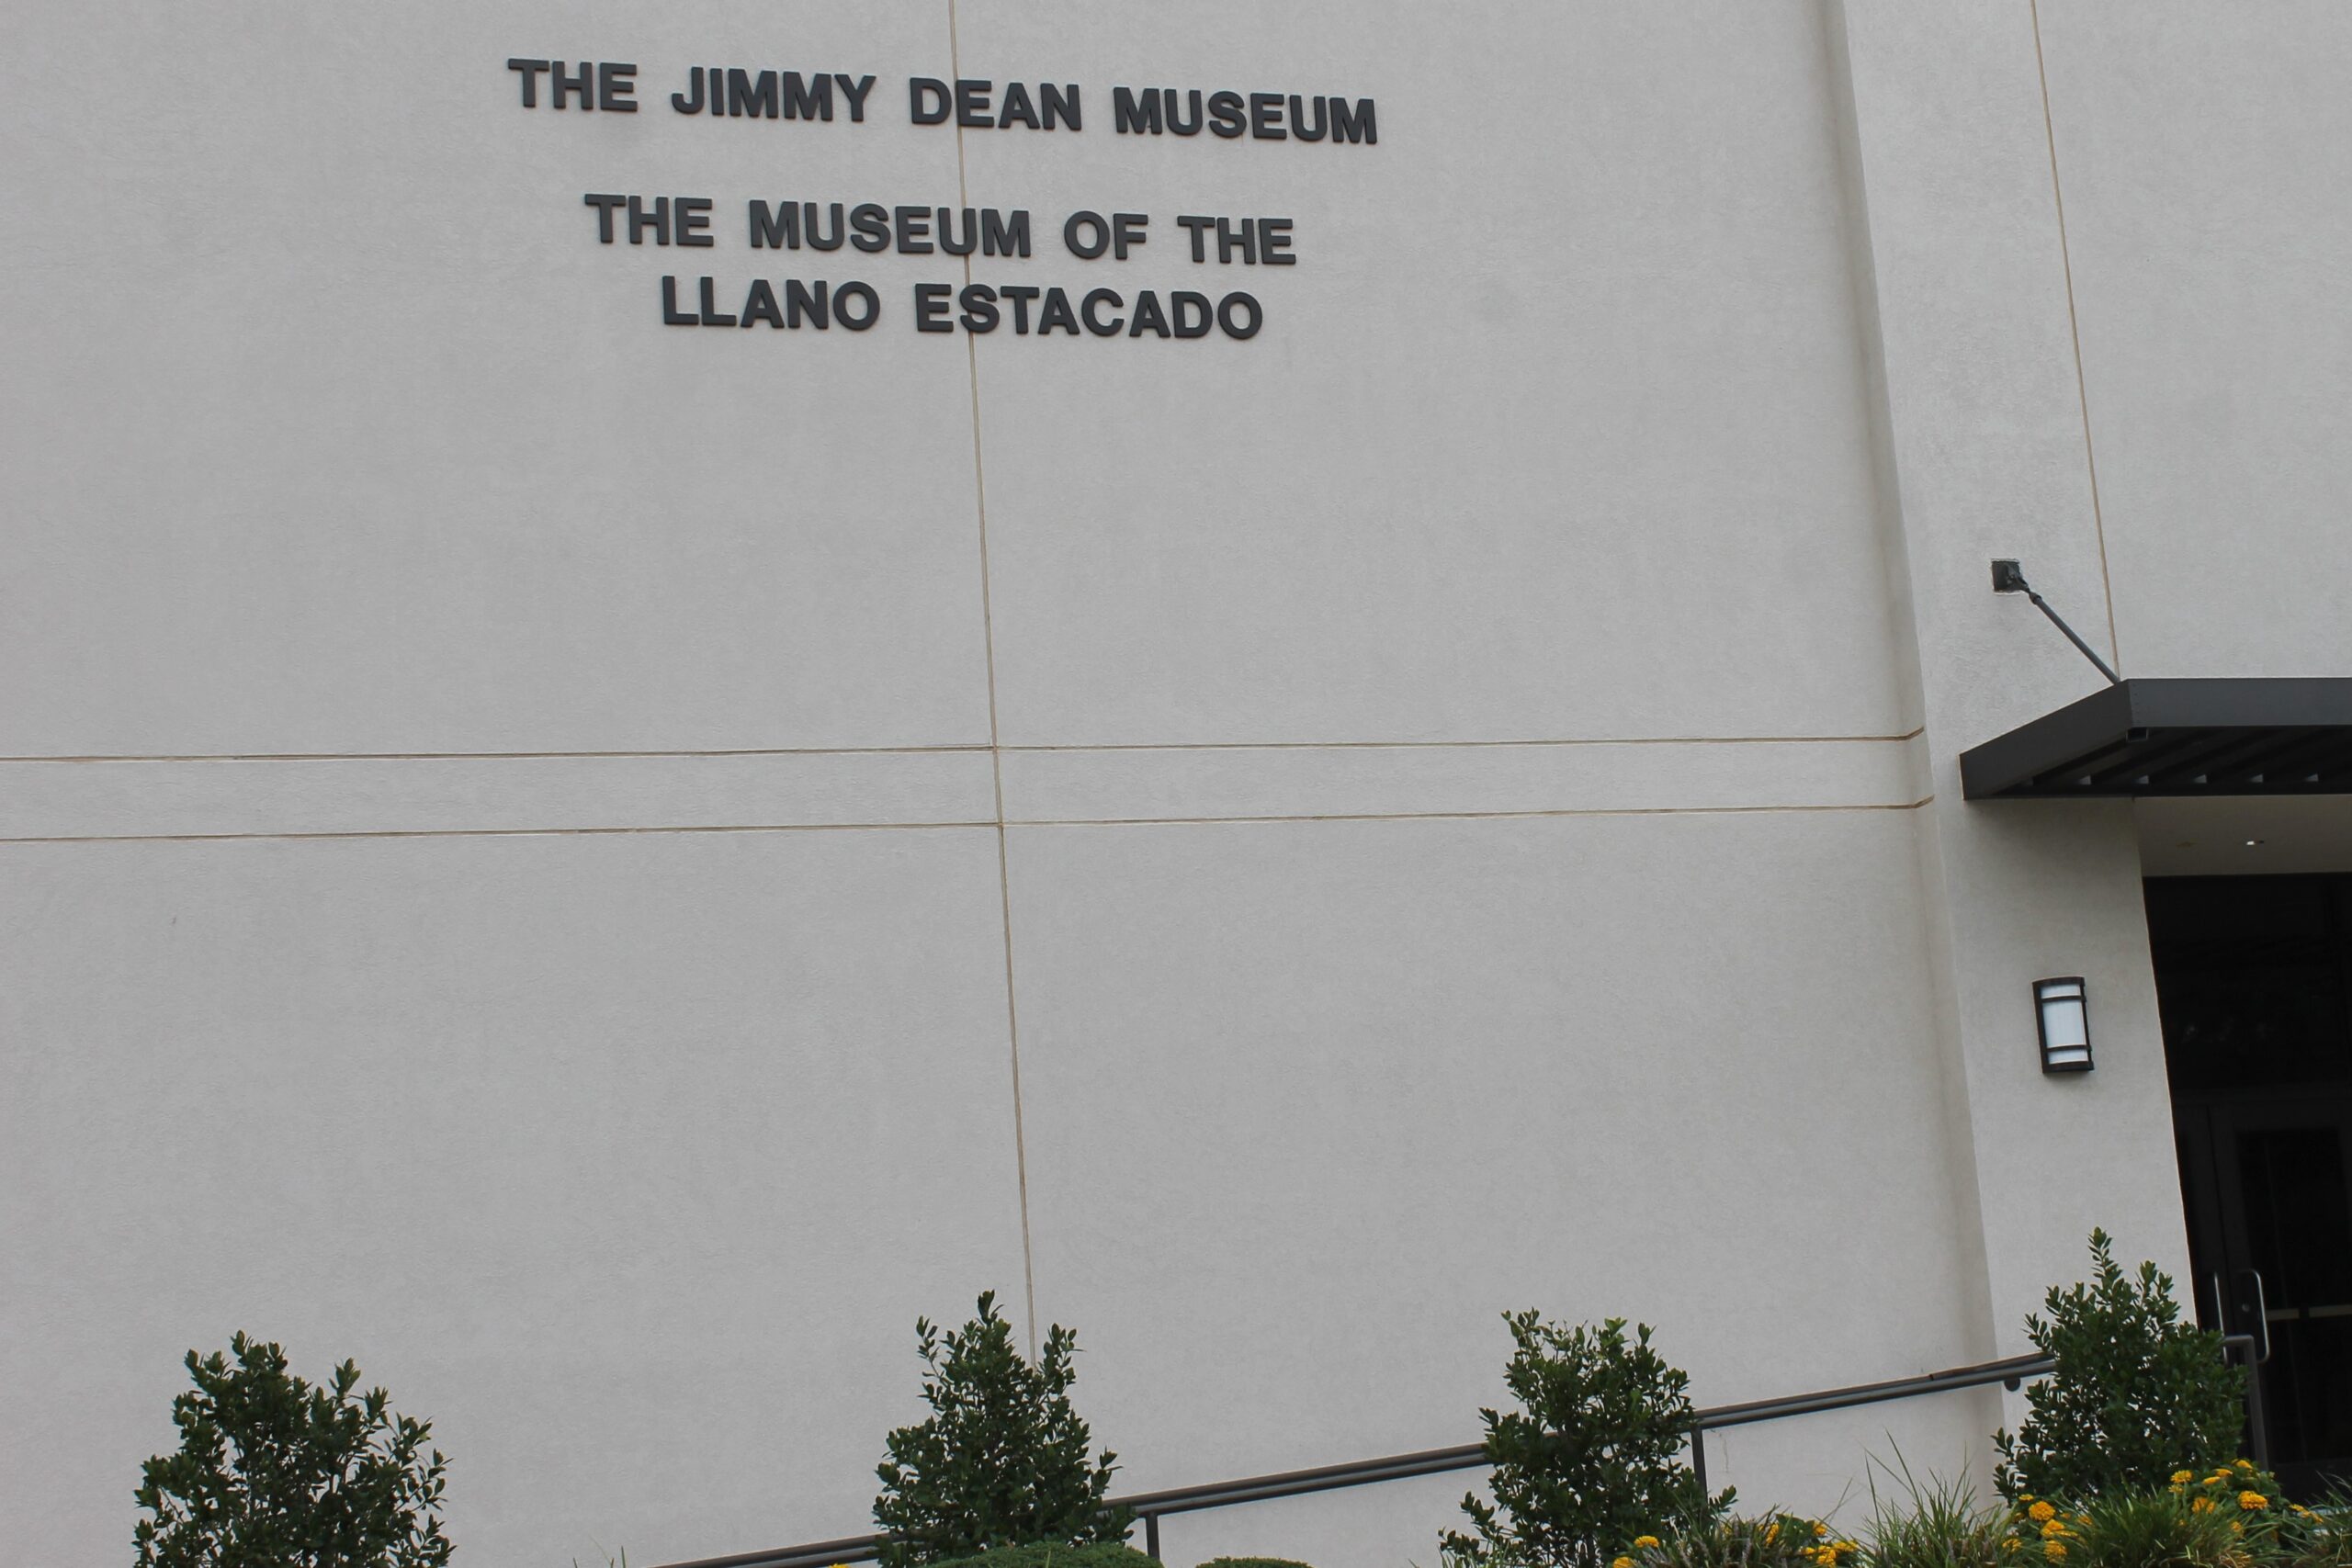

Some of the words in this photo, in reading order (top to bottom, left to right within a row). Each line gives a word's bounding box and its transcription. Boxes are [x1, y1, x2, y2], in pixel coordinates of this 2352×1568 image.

[507, 59, 639, 113] THE
[672, 67, 876, 123] JIMMY
[910, 78, 1081, 131] DEAN
[1114, 87, 1378, 145] MUSEUM
[584, 194, 715, 248] THE
[749, 199, 1031, 258] MUSEUM
[1064, 211, 1148, 261] OF
[1177, 216, 1297, 265] THE
[662, 276, 880, 333] LLANO
[915, 283, 1263, 341] ESTACADO
